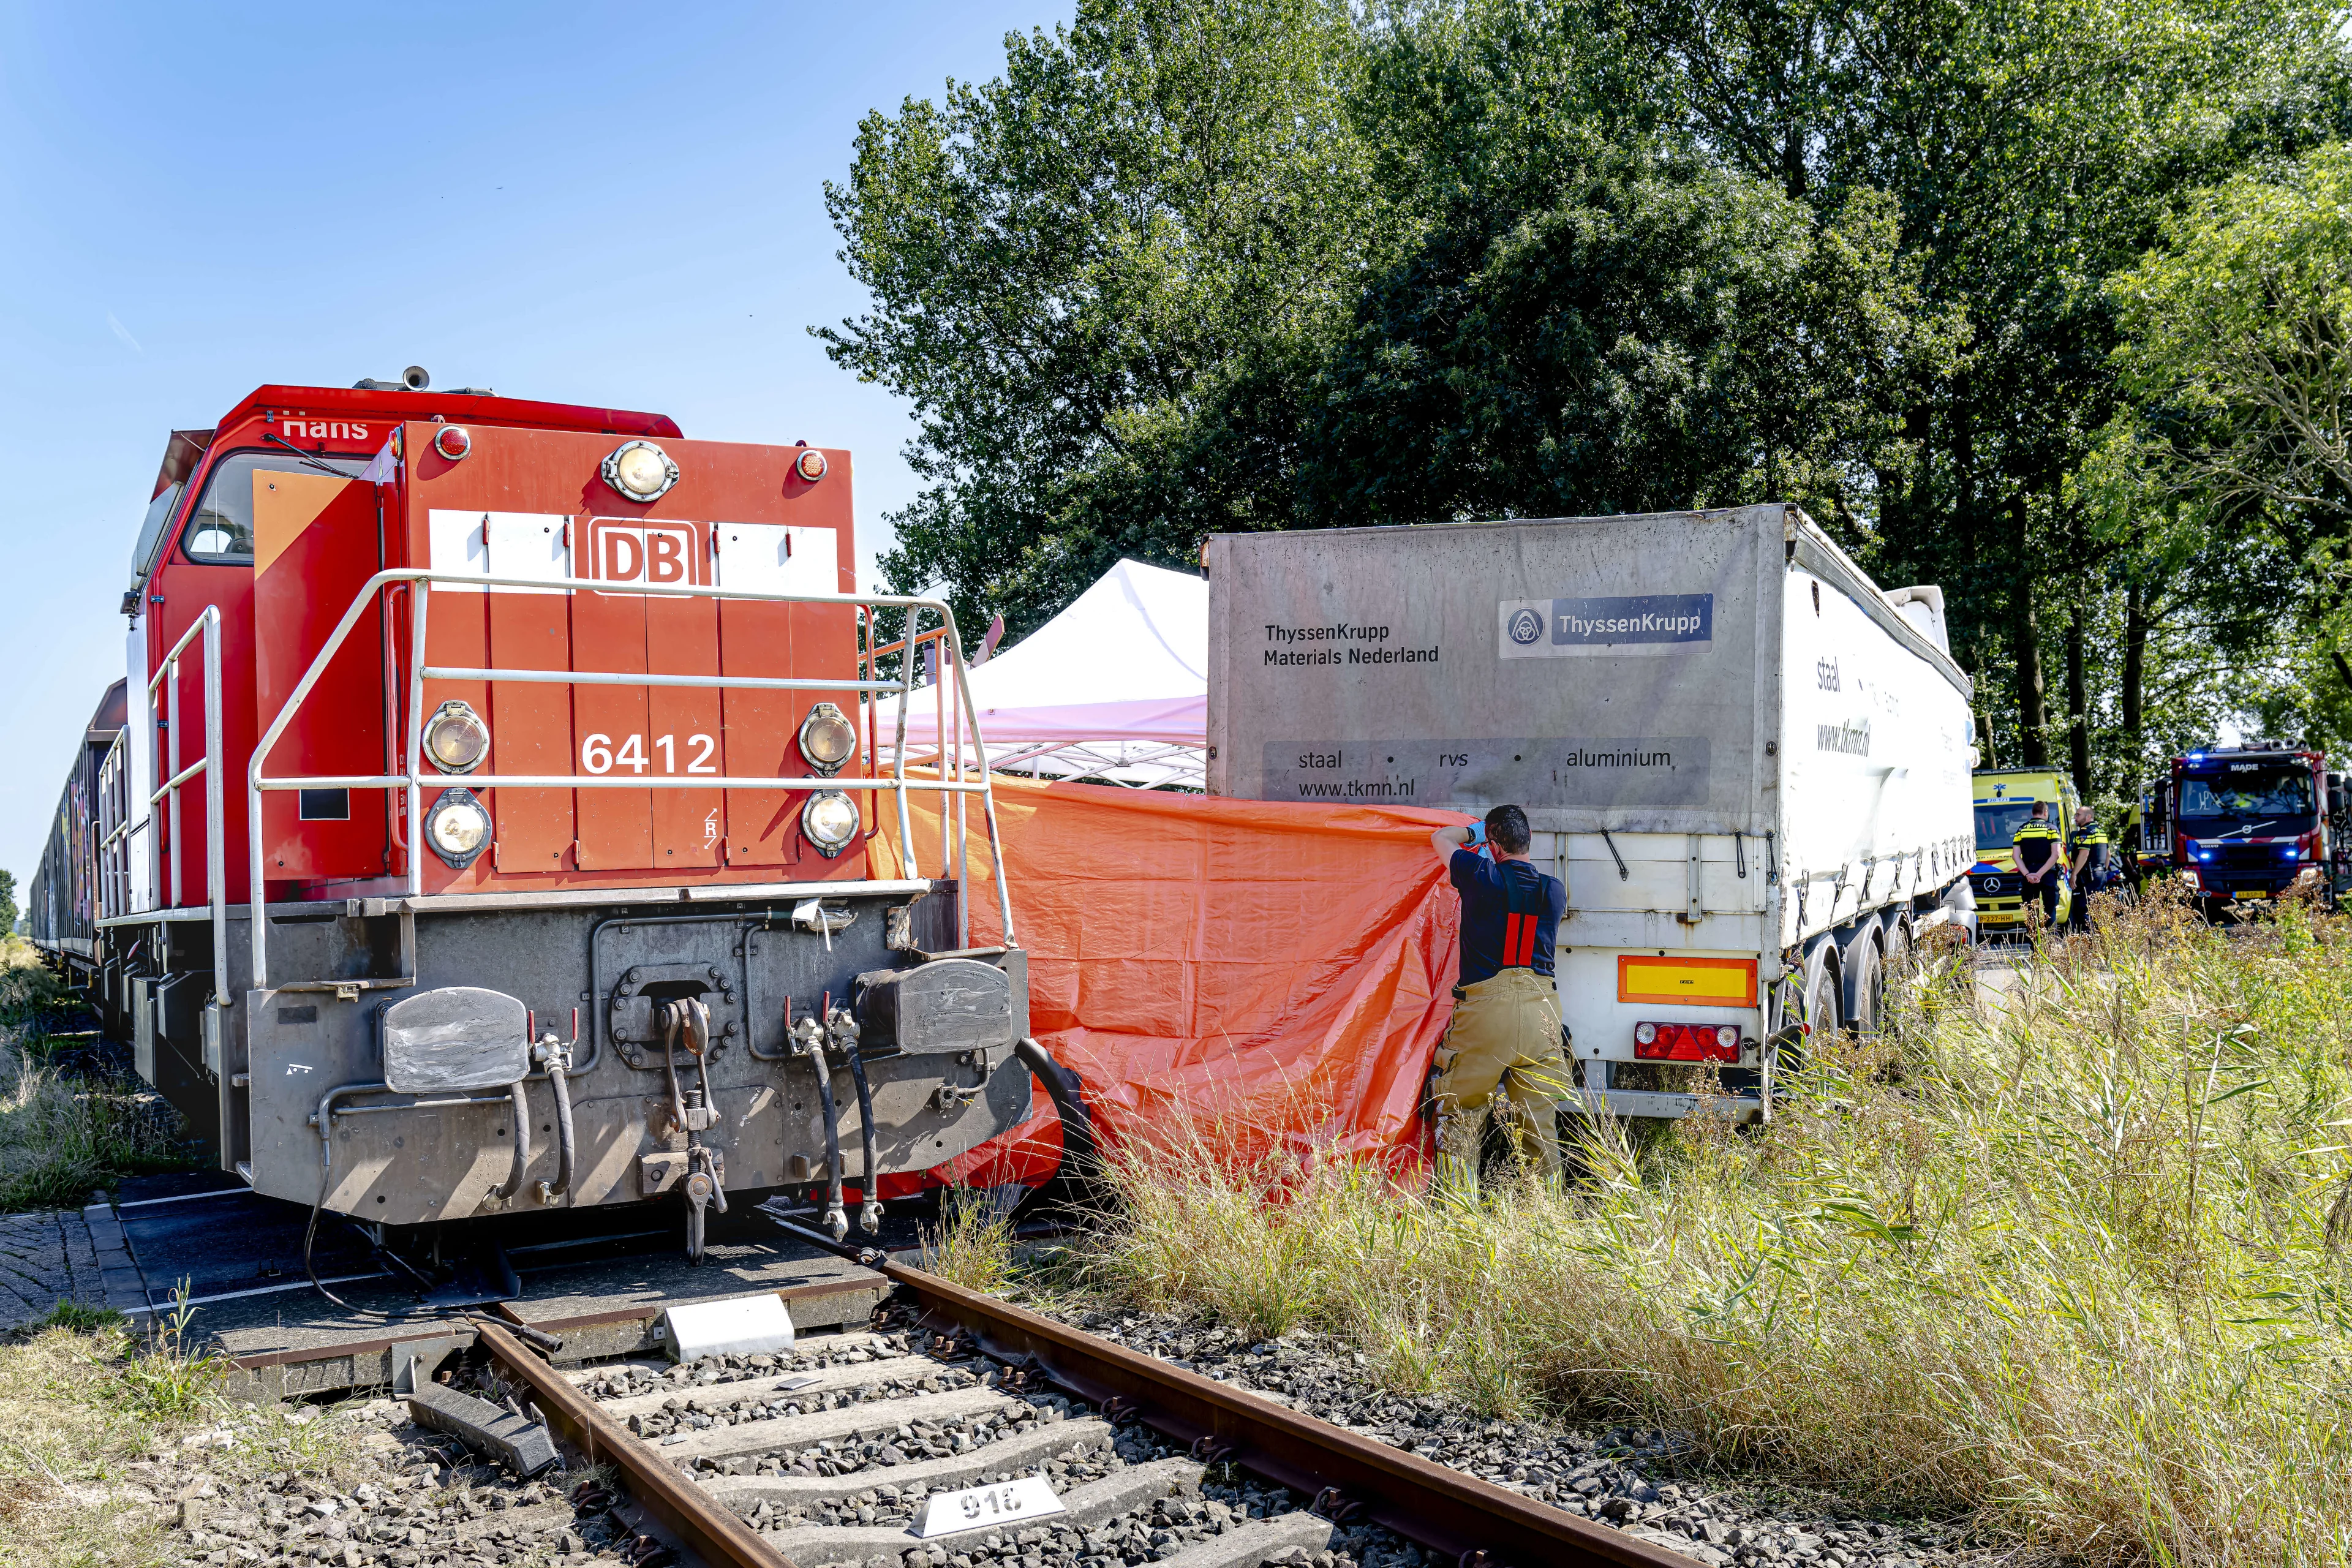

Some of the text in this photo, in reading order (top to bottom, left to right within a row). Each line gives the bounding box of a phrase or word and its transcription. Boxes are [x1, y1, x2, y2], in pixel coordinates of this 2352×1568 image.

[283, 410, 368, 440] Hans
[605, 532, 684, 582] DB
[1265, 624, 1389, 644] ThyssenKrupp
[1559, 613, 1701, 636] ThyssenKrupp
[1264, 646, 1439, 666] Materials Nederland
[1817, 656, 1841, 692] staal
[1818, 718, 1871, 757] www.tkmn.nl
[582, 733, 716, 774] 6412
[1298, 748, 1670, 768] staal rvs aluminium
[1298, 778, 1414, 797] www.tkmn.nl
[706, 822, 717, 835] R
[960, 1488, 1022, 1519] 918
